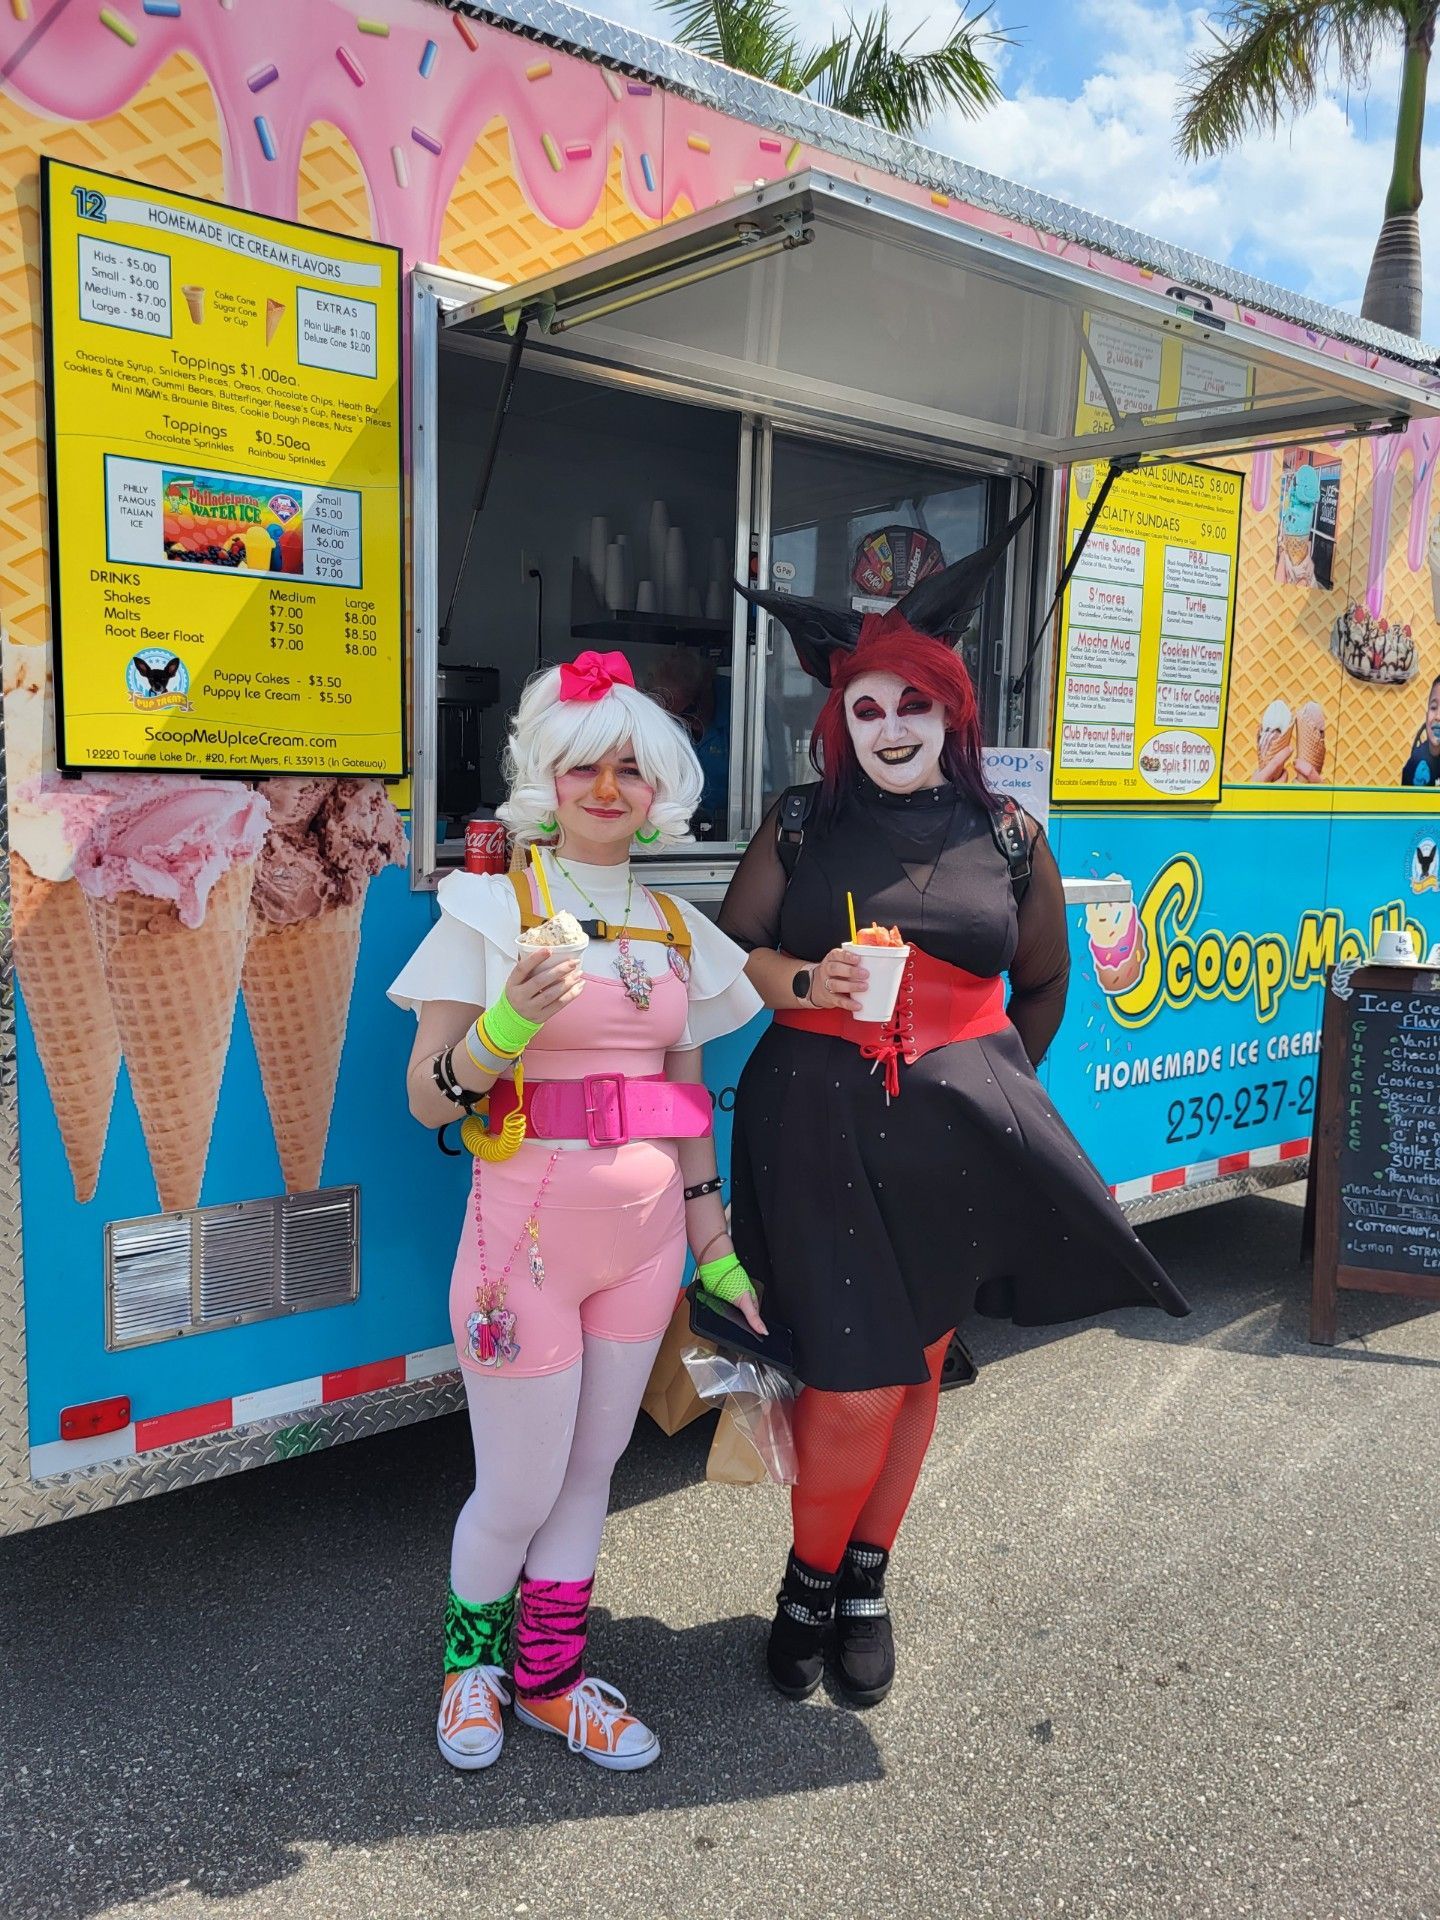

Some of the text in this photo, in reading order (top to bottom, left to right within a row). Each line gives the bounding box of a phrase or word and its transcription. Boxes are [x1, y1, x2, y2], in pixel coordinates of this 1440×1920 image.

[71, 185, 341, 278] 12 HOMEMADE ICE CREAM FLAVORS
[94, 250, 156, 274] Kids $5.00
[92, 266, 159, 290] Small $6.00
[85, 282, 166, 308] Medium $7.00
[214, 290, 256, 306] Cake Cone
[92, 300, 160, 323] Large $8.00
[214, 301, 258, 318] Sugar Cone
[316, 300, 358, 318] EXTRAS
[234, 316, 248, 327] Cup
[304, 319, 370, 341] Plain Waffle $1.00
[304, 332, 328, 344] Deluxe
[330, 336, 348, 349] Cone
[171, 350, 235, 376] Toppings
[76, 350, 124, 368] Chocolate
[159, 366, 196, 381] Snickers
[266, 387, 308, 401] Chocolate
[338, 400, 362, 412] Heath
[64, 360, 102, 376] Cookies
[106, 368, 113, 378] &
[152, 378, 184, 392] Gummi
[274, 400, 308, 414] Reese's
[331, 410, 363, 423] Reese's
[112, 382, 132, 394] Mini
[172, 394, 208, 408] Brownie
[240, 406, 270, 419] Cookie
[272, 411, 300, 425] Dough
[334, 422, 353, 433] Nuts
[162, 415, 310, 451] Toppings $0.50ea
[145, 430, 326, 468] Chocolate Sprinkles Rainbow Sprinkles
[123, 484, 148, 494] PHILLY
[1162, 468, 1204, 489] SUNDAES
[1210, 478, 1234, 495] $8.00
[118, 495, 156, 507] FAMOUS
[188, 487, 259, 507] Philadelphia
[316, 494, 342, 506] Small
[120, 507, 153, 518] ITALIAN
[189, 502, 237, 520] WATER
[240, 504, 262, 524] ICE
[315, 507, 342, 520] $5.00
[130, 520, 143, 528] ICE
[311, 524, 350, 538] Medium
[1137, 511, 1180, 531] SUNDAES
[1200, 523, 1227, 540] $9.00
[316, 537, 344, 550] $6.00
[1112, 539, 1140, 556] Sundae
[316, 554, 342, 567] Large
[90, 570, 141, 586] DRINKS
[315, 566, 343, 579] $7.00
[782, 567, 792, 576] Pay
[269, 589, 375, 611] Medium Large
[1089, 587, 1125, 604] S'mores
[104, 590, 377, 626] Shakes $7.00 $8.00
[1186, 597, 1206, 612] Turtle
[104, 608, 377, 642] Malts $7.50 $8.50
[105, 624, 377, 657] Root Beer Float $7.00 $8.00
[1077, 632, 1131, 650] Mocha Mud
[1162, 642, 1189, 658] Cookies
[214, 670, 342, 688] Puppy Cakes $3.50
[1068, 678, 1134, 696] Banana Sundae
[137, 699, 154, 708] PUP
[204, 685, 352, 705] Puppy Ice Cream $5.50
[1194, 689, 1220, 704] Cookie
[144, 727, 337, 748] ScoopMeUpIceCream.com
[1063, 725, 1133, 741] Club Peanut Butter
[1152, 740, 1211, 754] Classic Banana
[85, 749, 120, 761] 12220
[123, 750, 156, 762] Towne
[159, 752, 182, 762] Lake
[230, 754, 248, 764] Fort
[295, 756, 325, 766] 33913
[1162, 758, 1209, 774] Split $11.00
[1002, 779, 1032, 788] Cakes
[1109, 853, 1291, 1026] Scoop
[1358, 994, 1403, 1013] Ice
[1094, 1045, 1222, 1092] HOMEMADE
[1230, 1040, 1258, 1068] ICE
[1378, 1072, 1435, 1089] Cookies
[1381, 1088, 1431, 1103] Special
[1387, 1142, 1431, 1156] Stellar
